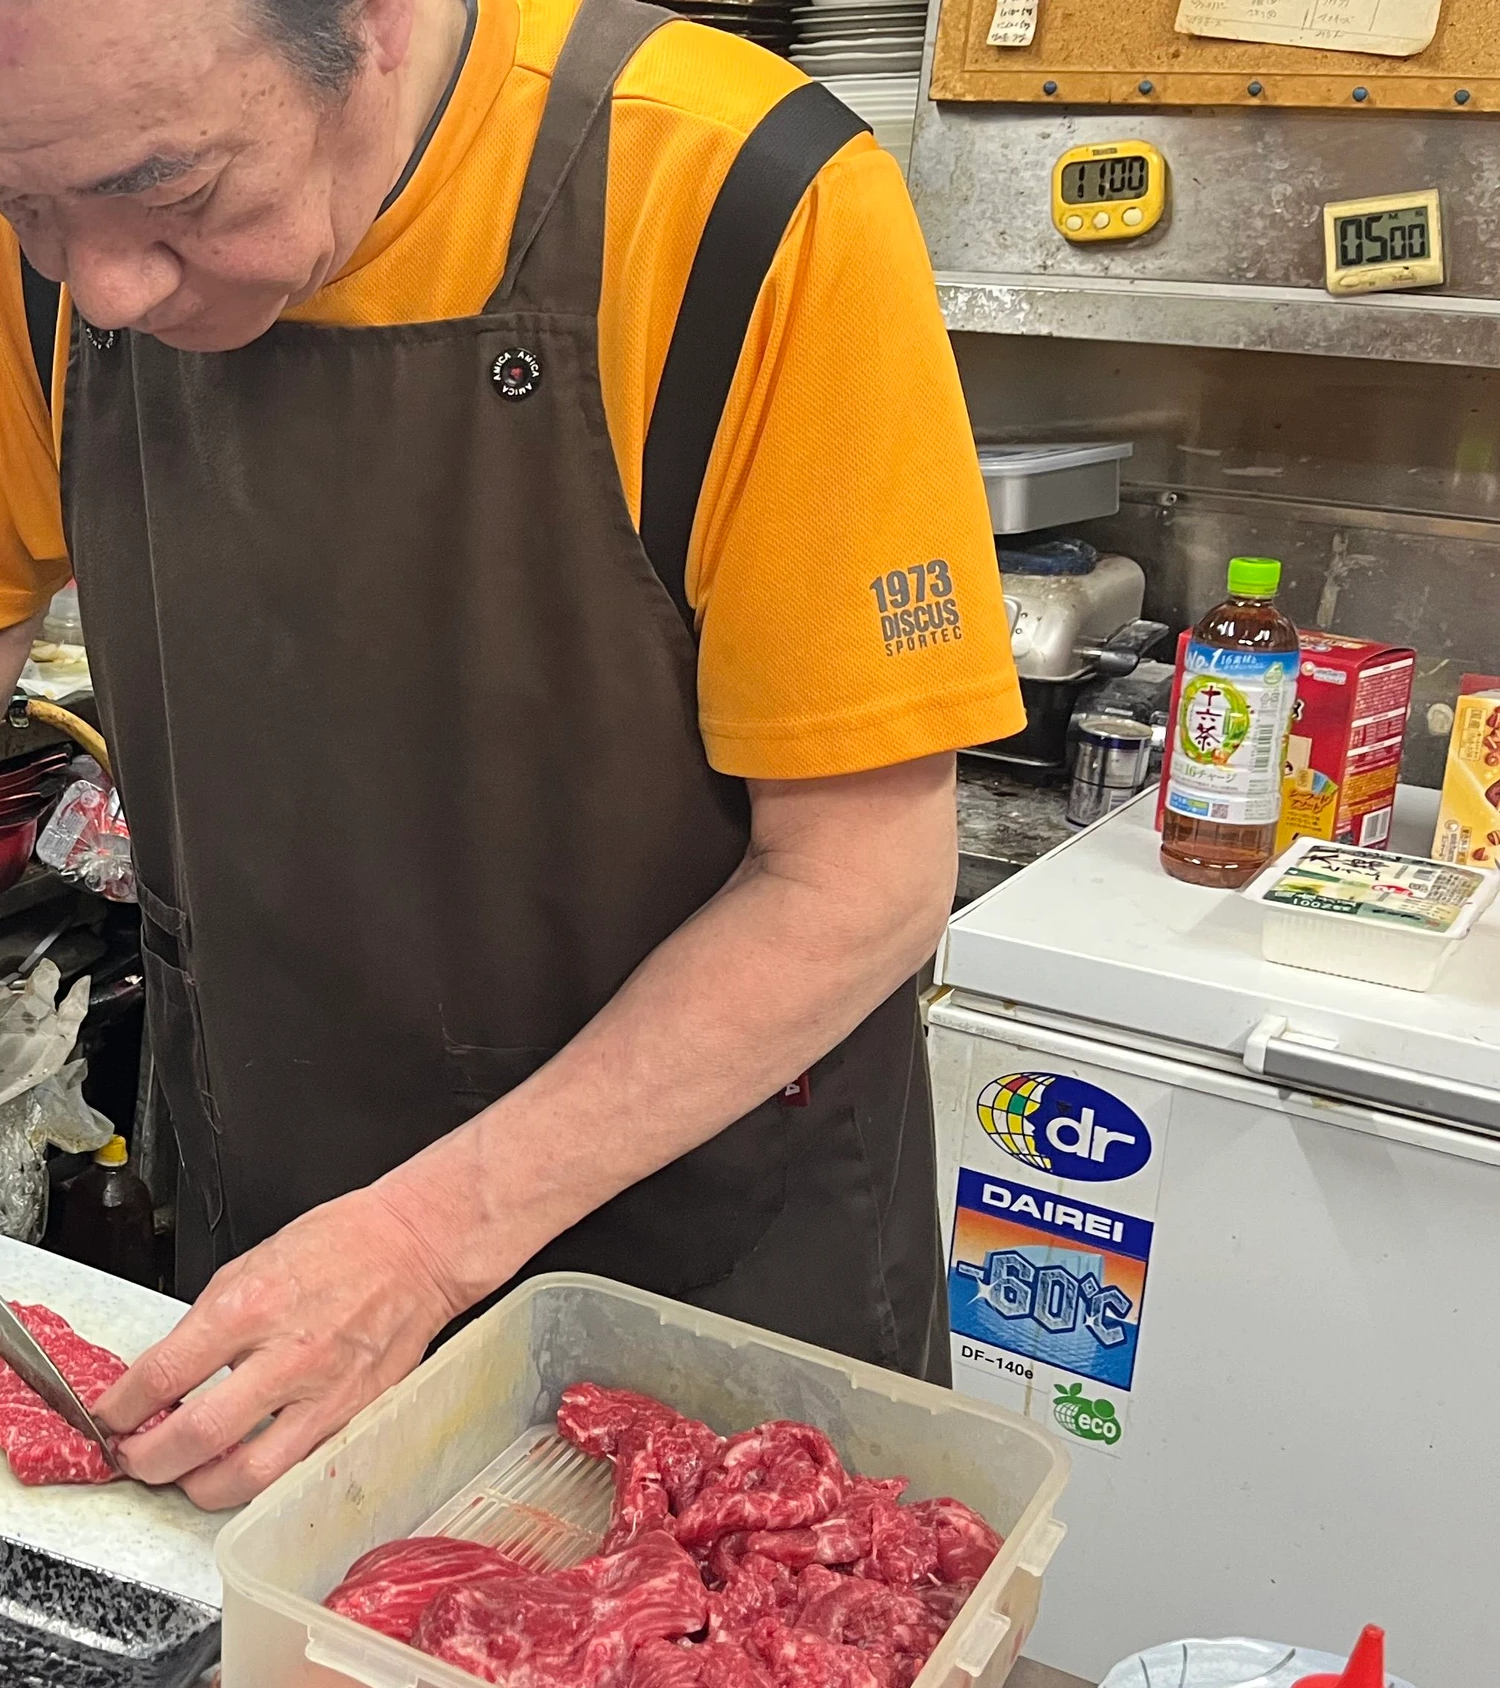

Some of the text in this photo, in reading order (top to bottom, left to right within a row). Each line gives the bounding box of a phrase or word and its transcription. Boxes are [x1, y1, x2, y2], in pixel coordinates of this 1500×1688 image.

[493, 352, 512, 381] AMICA
[518, 350, 540, 378] AMICA
[502, 382, 533, 396] AMICA
[869, 559, 953, 613] 1973
[880, 598, 960, 642] DISCUS
[884, 625, 963, 657] SPORTEC
[1194, 685, 1222, 751] 十六茶
[1046, 1107, 1136, 1164] dr
[981, 1182, 1125, 1243] DAIREI
[960, 1344, 1035, 1381] DF-140e
[1077, 1411, 1118, 1439] eco
